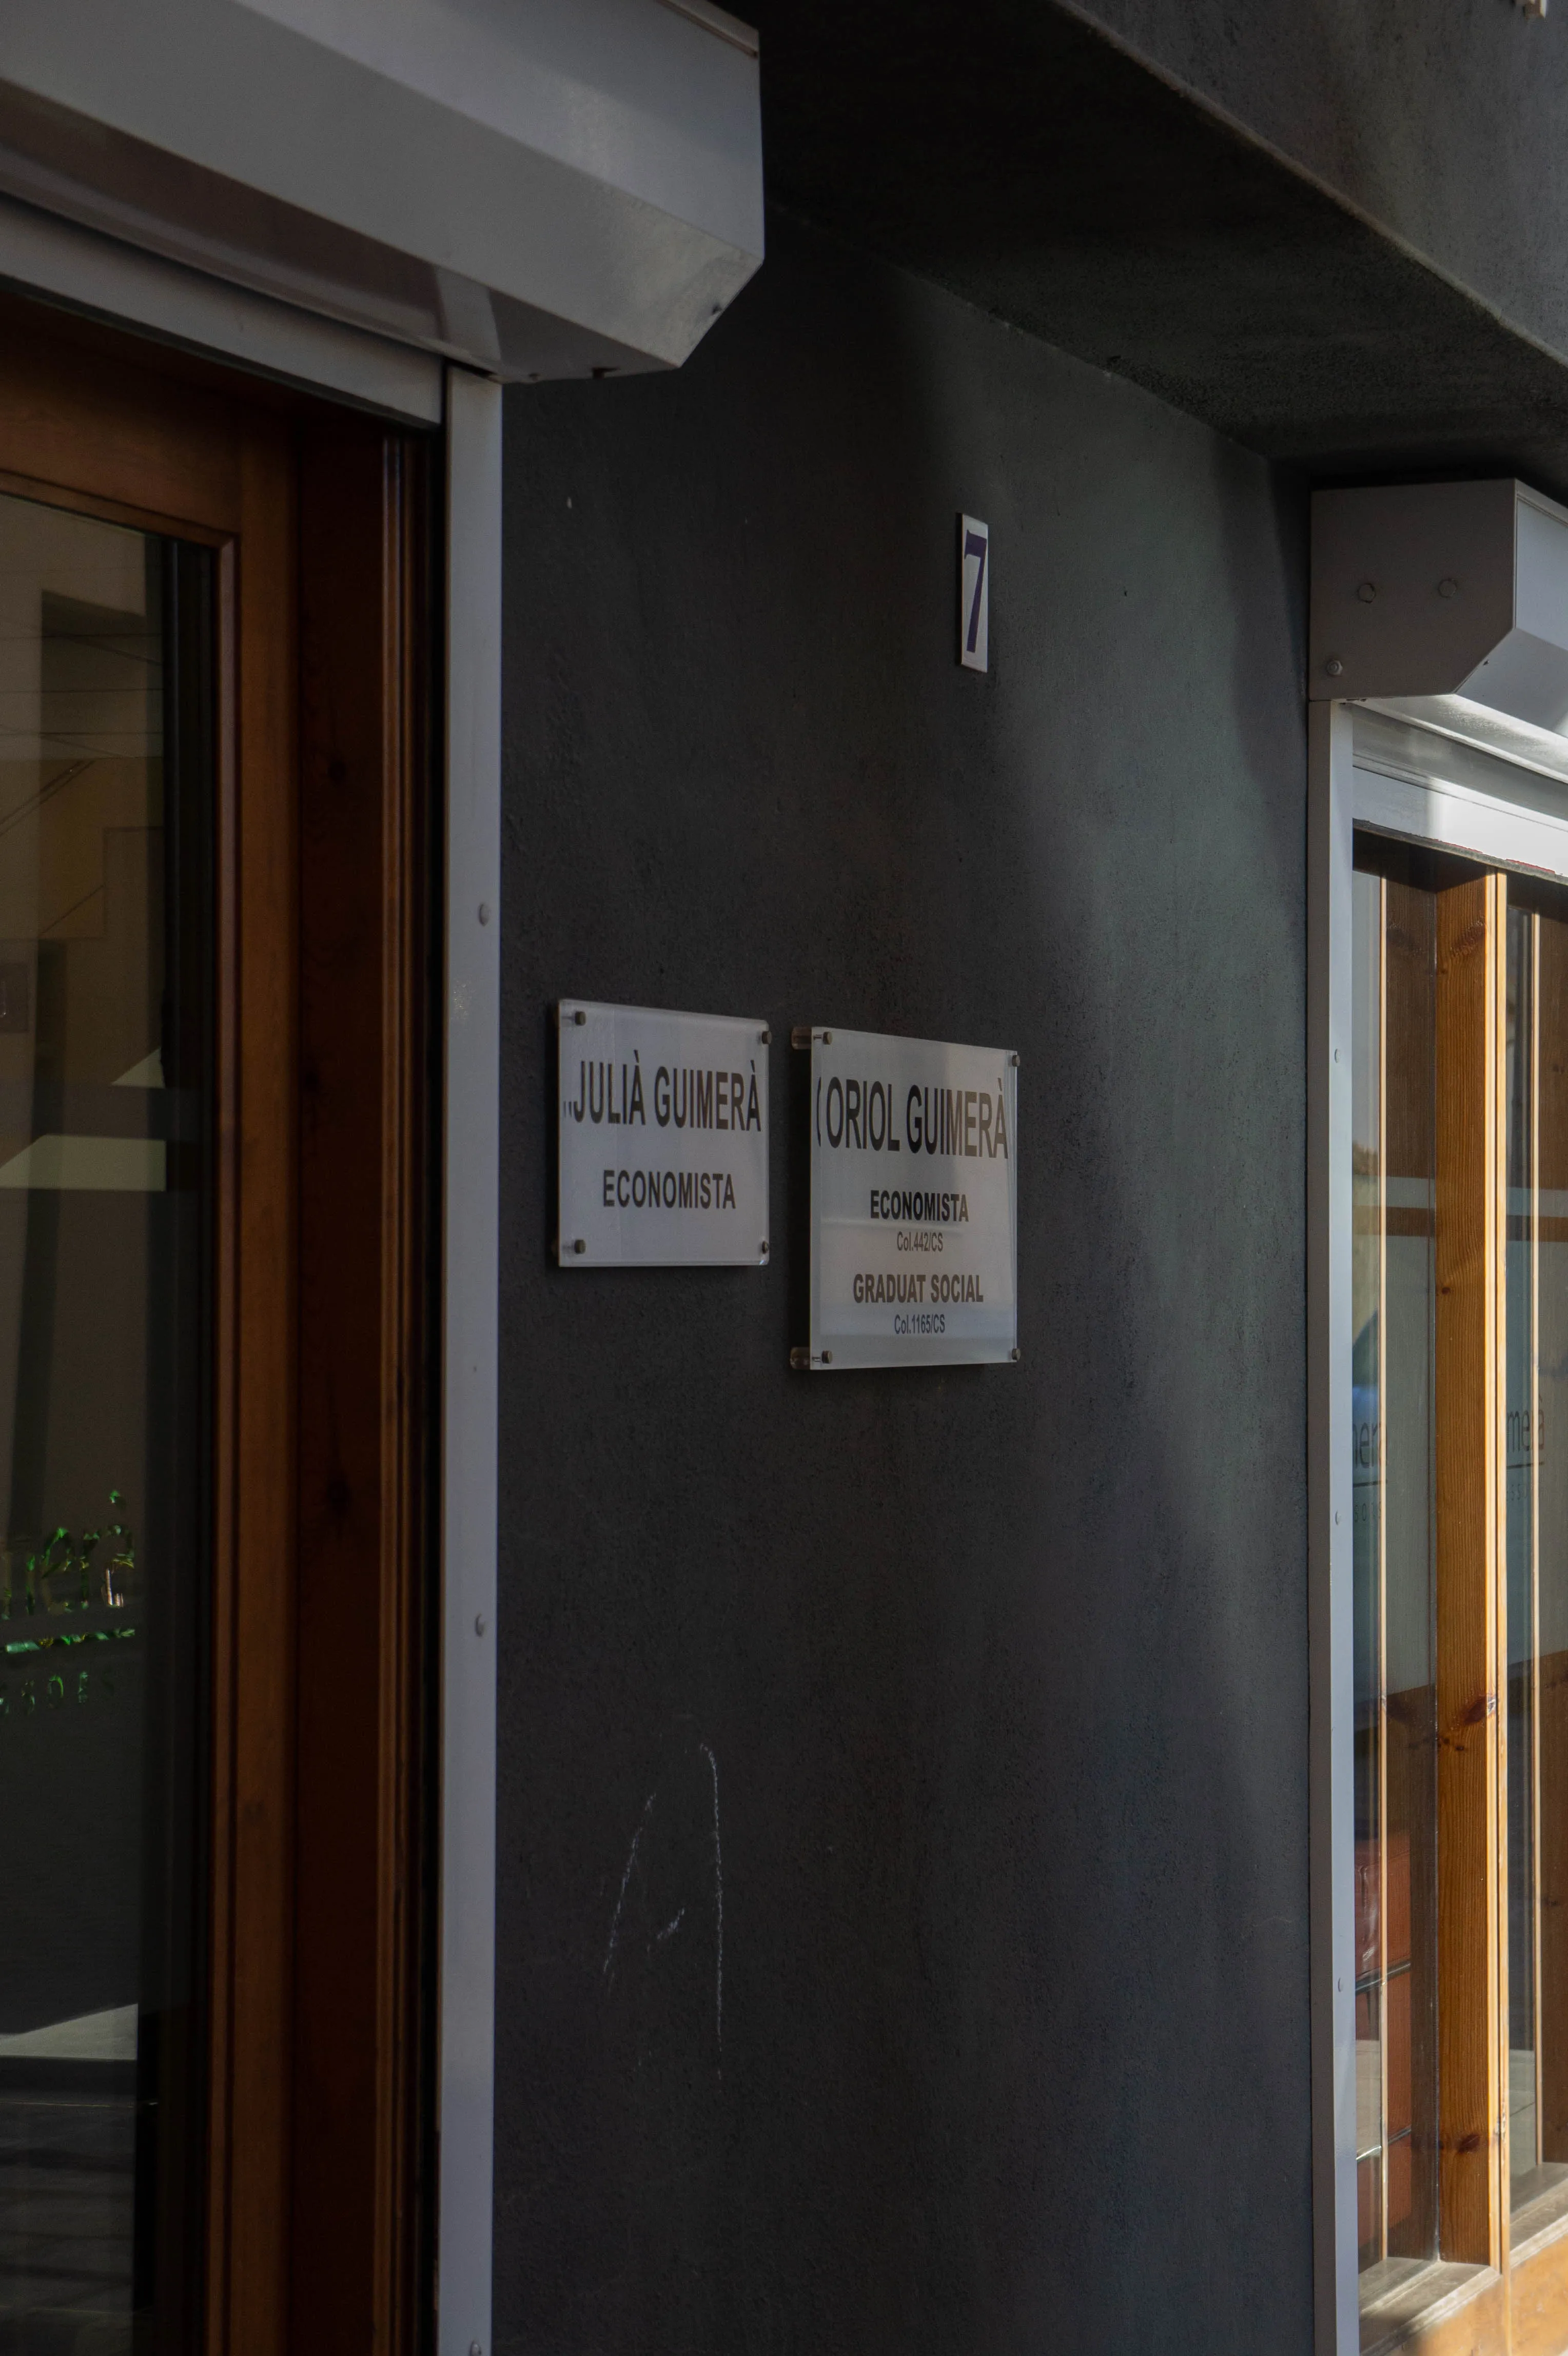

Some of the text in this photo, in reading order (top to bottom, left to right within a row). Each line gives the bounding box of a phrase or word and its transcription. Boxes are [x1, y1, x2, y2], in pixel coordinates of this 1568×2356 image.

[964, 529, 987, 653] 7
[573, 1049, 762, 1132] JULIÀ GUIMERÀ
[826, 1076, 1009, 1160] ORIOL GUIMERÀ
[602, 1169, 737, 1210] ECONOMISTA
[870, 1189, 970, 1223] ECONOMISTA
[853, 1273, 984, 1304] GRADUAT SOCIAL
